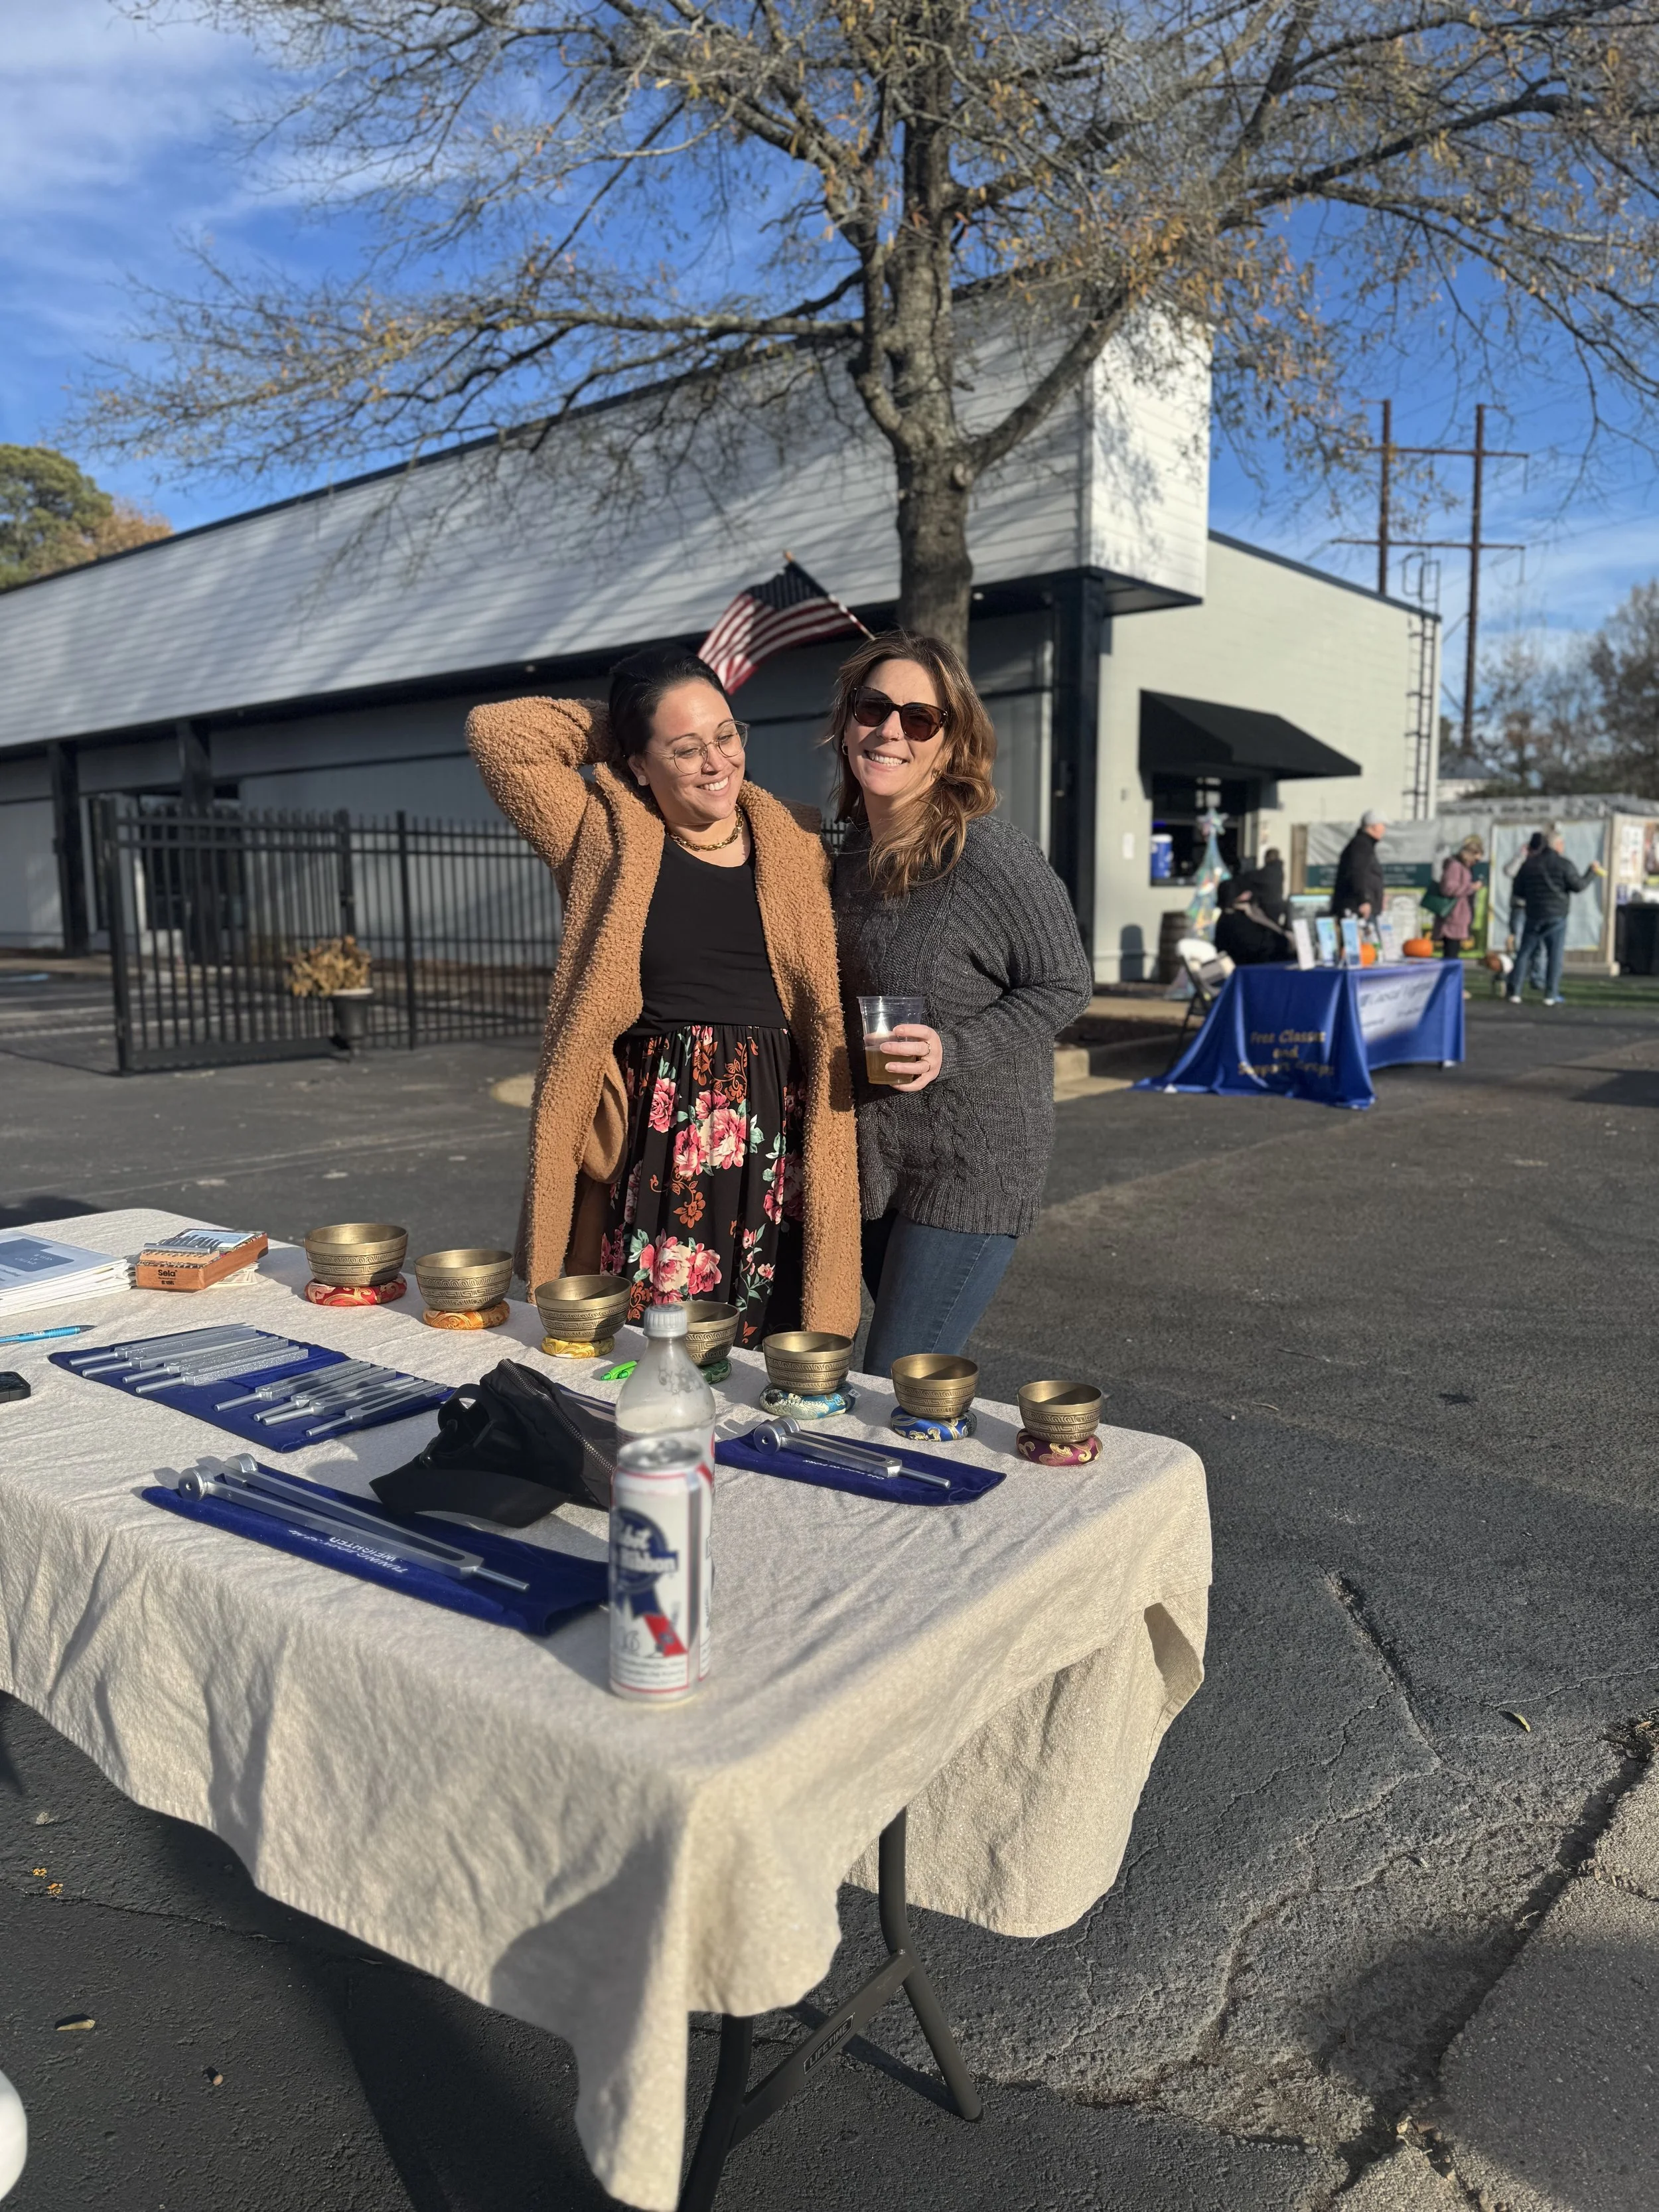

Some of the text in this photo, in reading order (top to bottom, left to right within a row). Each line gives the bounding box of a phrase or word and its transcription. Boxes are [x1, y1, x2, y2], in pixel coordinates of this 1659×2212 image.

[1250, 1029, 1327, 1045] Free Classes
[810, 2022, 848, 2067] LIFETIME
